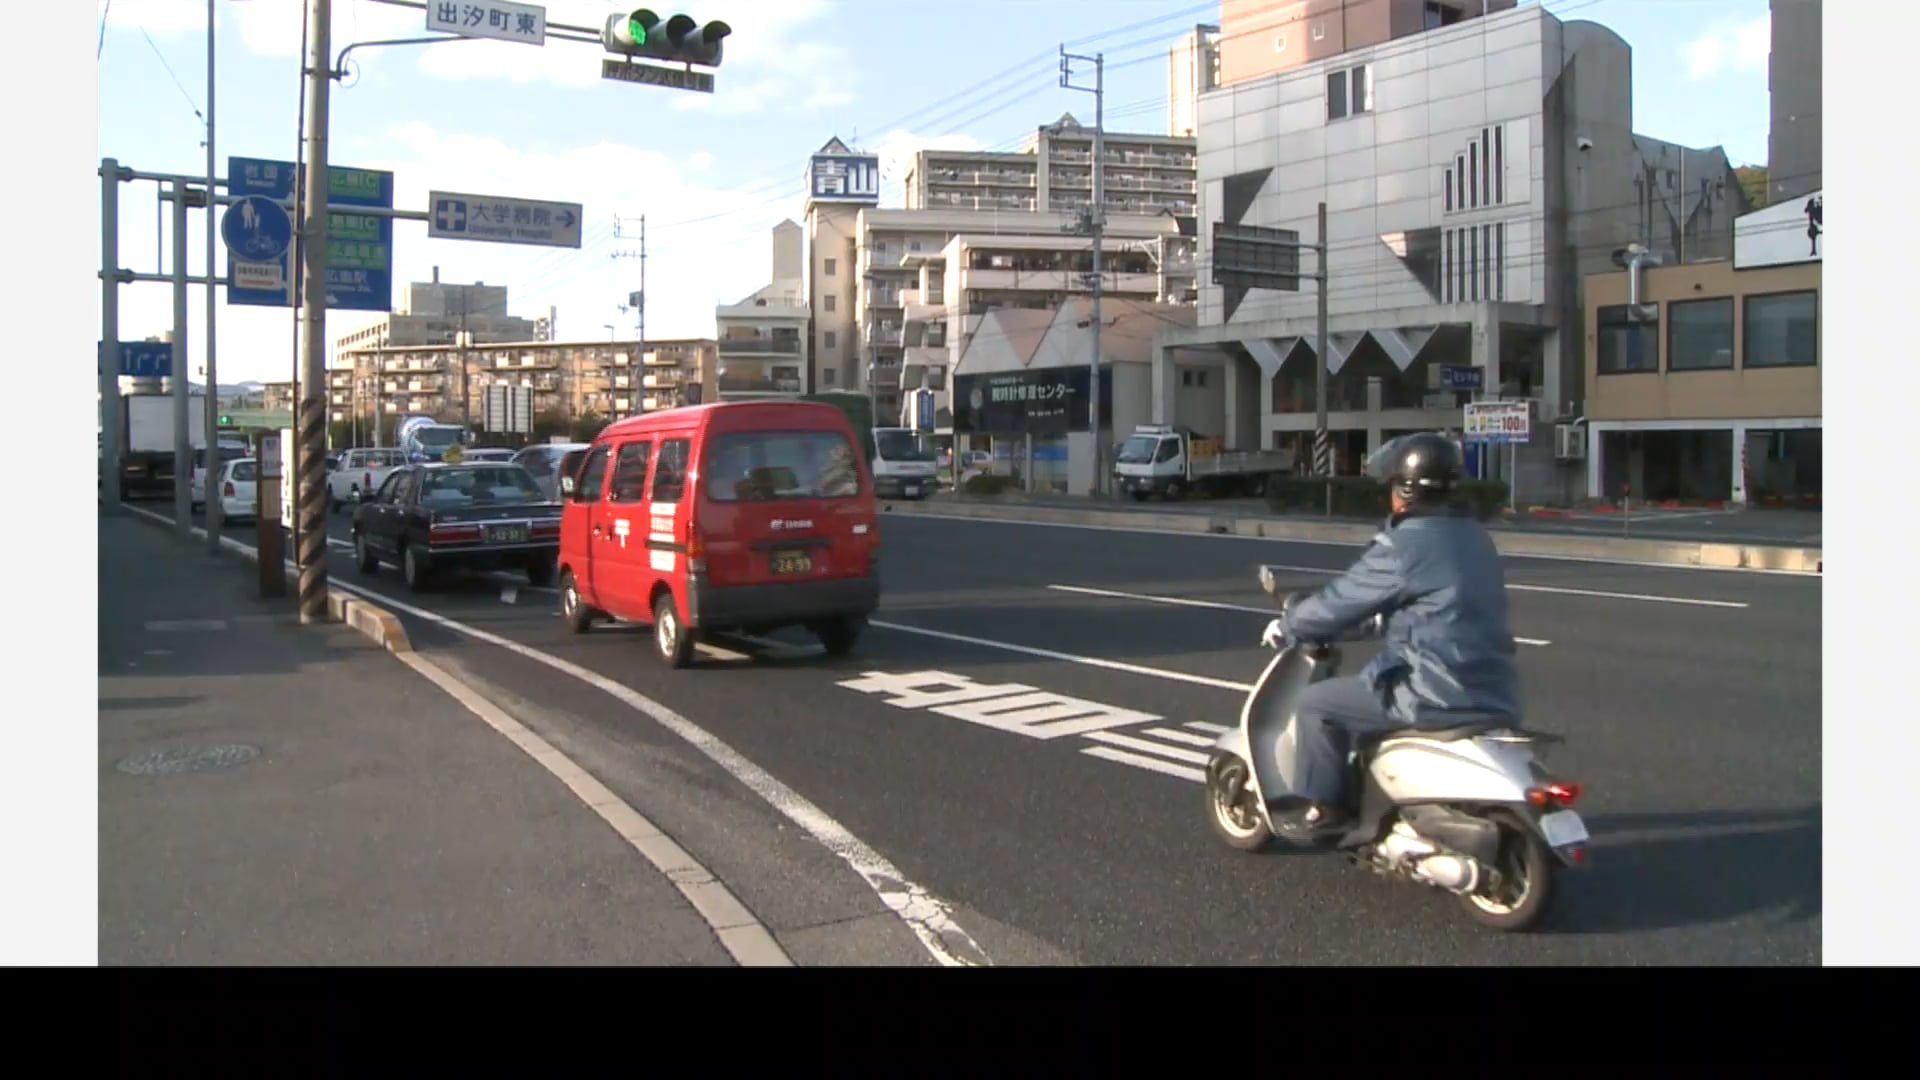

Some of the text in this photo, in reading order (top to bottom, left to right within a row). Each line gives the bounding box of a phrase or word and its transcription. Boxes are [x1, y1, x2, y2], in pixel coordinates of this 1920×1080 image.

[437, 1, 537, 35] 出汐町東
[814, 159, 878, 194] 青山
[471, 202, 552, 227] 大学病院
